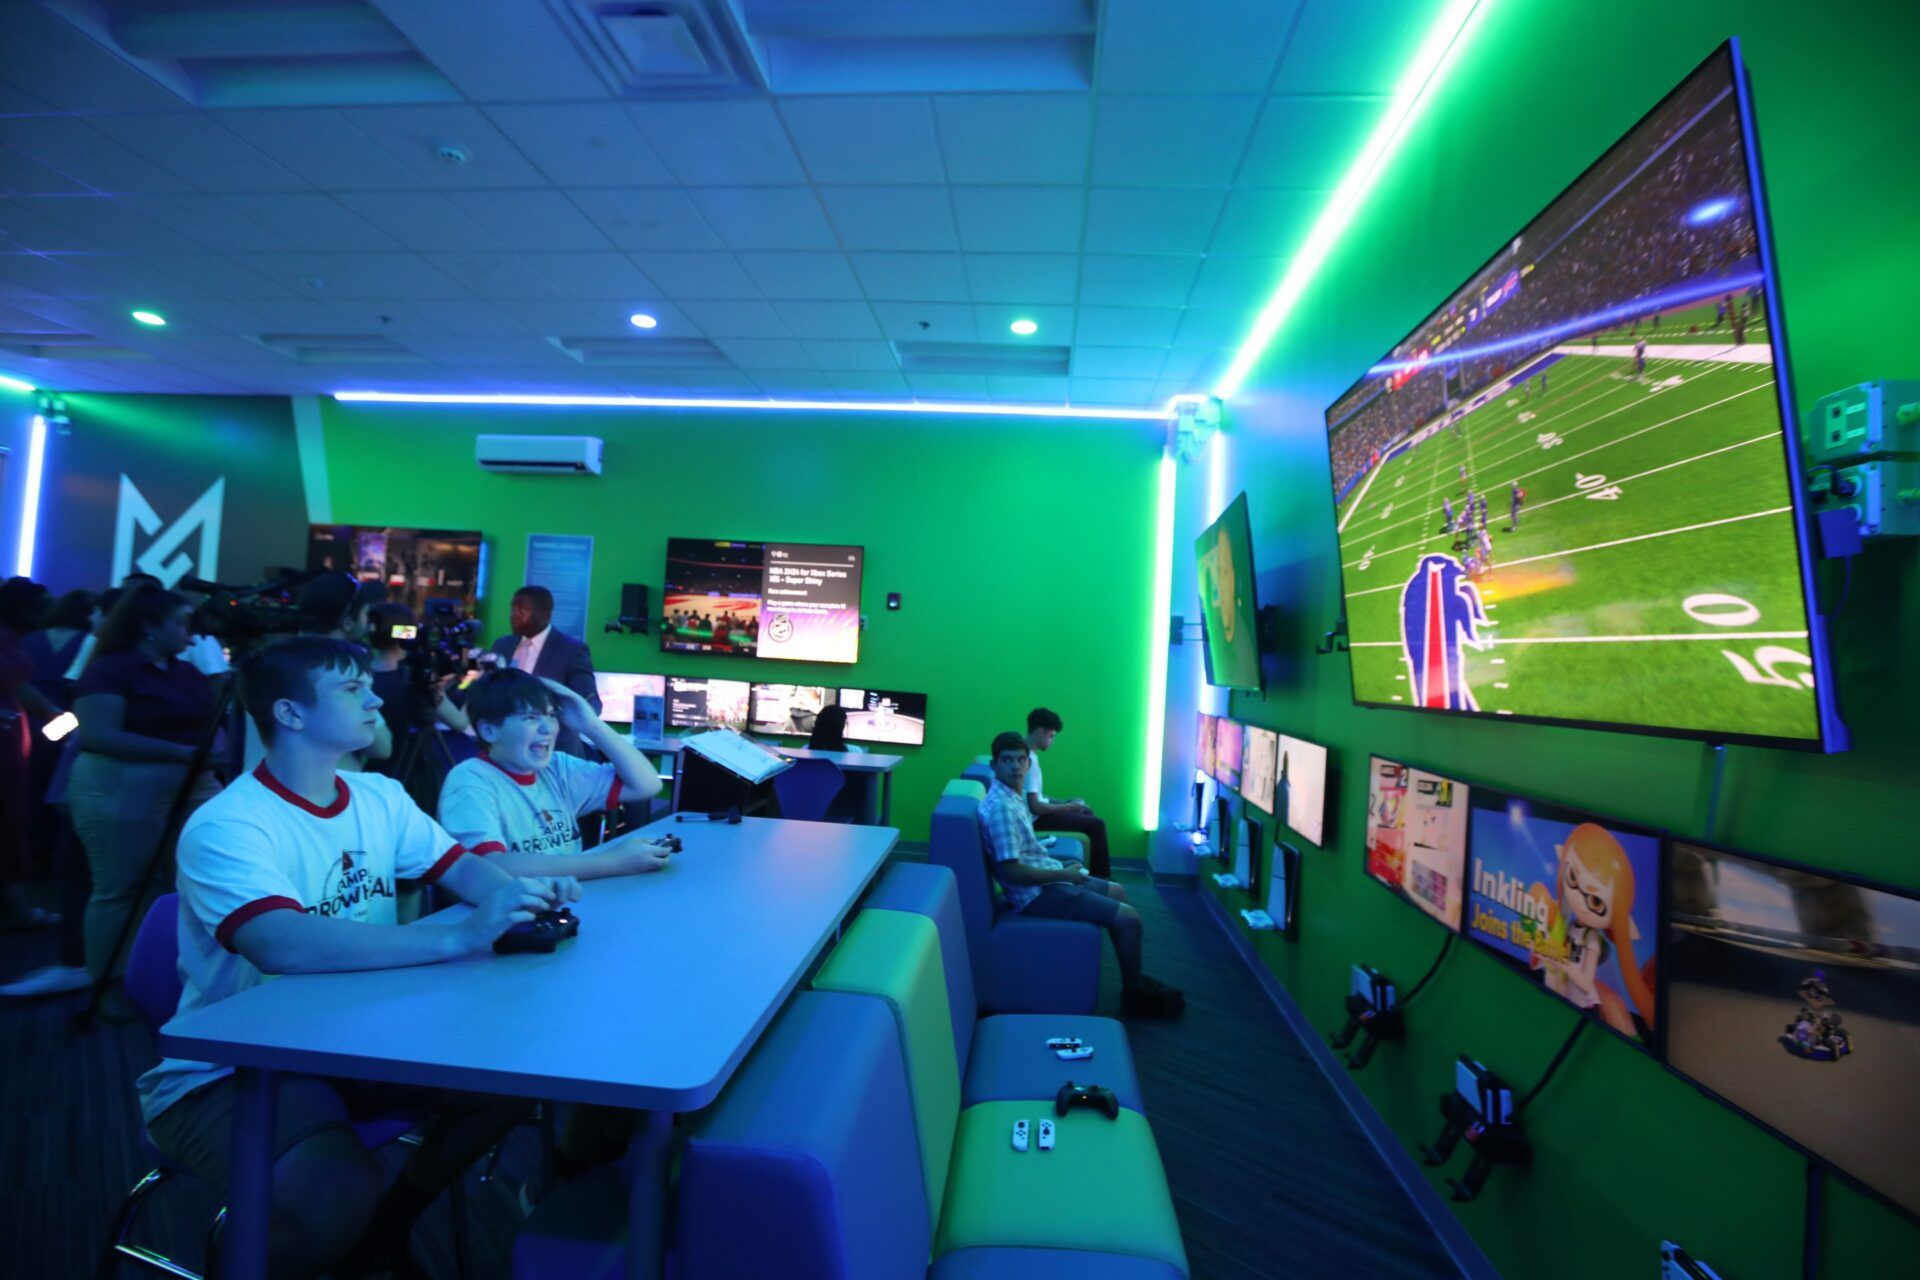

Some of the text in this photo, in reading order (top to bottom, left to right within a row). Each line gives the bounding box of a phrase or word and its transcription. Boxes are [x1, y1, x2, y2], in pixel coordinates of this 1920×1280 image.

[785, 576, 804, 585] Super
[826, 570, 847, 578] Series
[539, 821, 564, 835] AMP
[337, 868, 367, 893] AMP
[1473, 857, 1549, 943] Inkling
[1472, 902, 1508, 939] Joins
[1511, 921, 1532, 950] the
